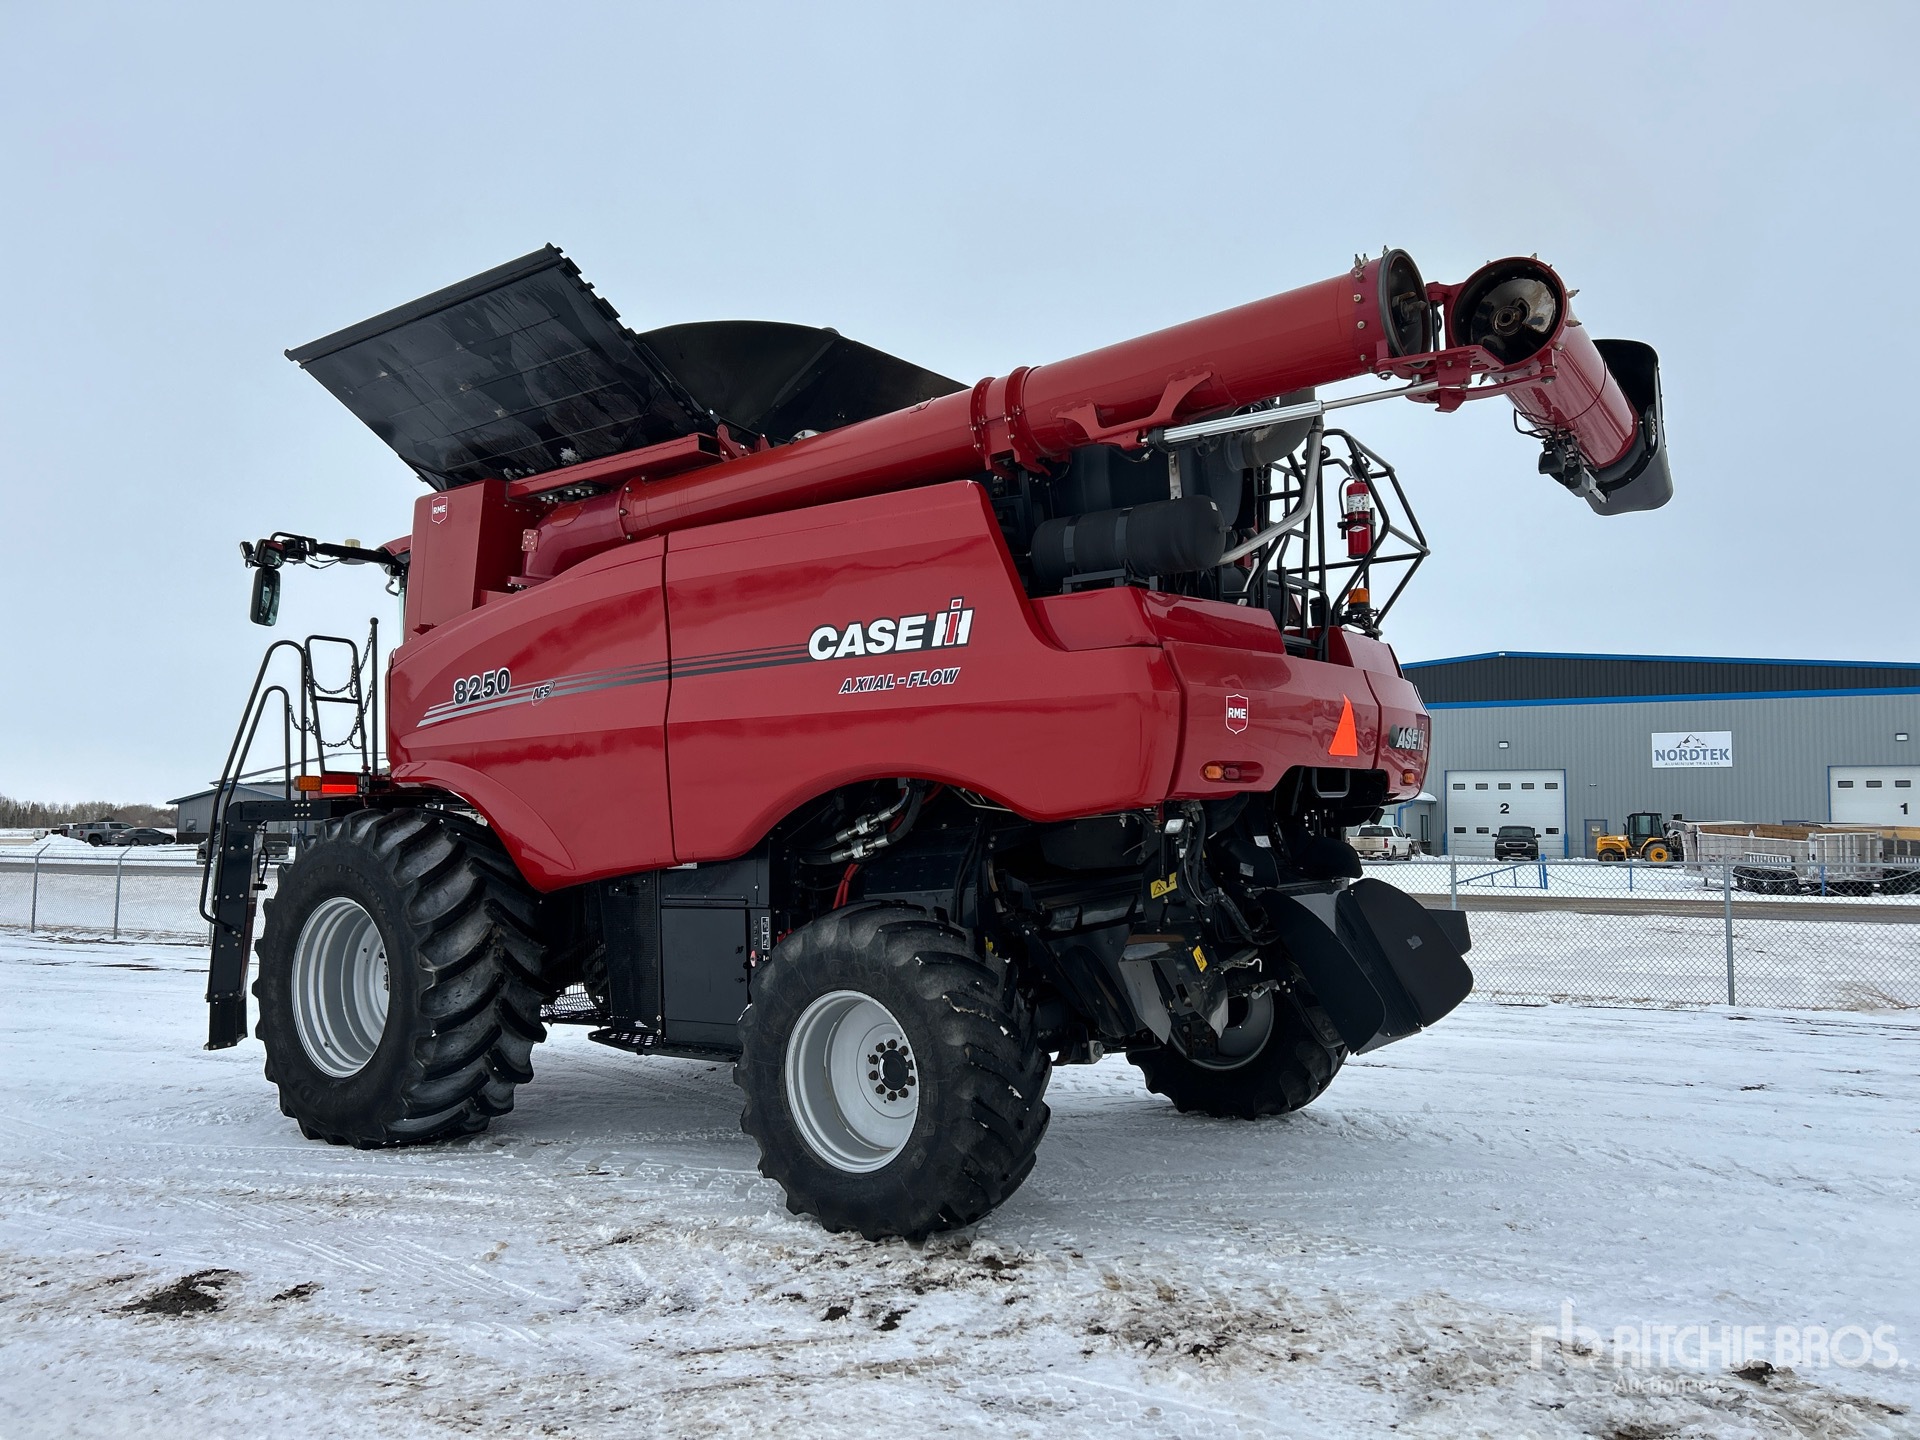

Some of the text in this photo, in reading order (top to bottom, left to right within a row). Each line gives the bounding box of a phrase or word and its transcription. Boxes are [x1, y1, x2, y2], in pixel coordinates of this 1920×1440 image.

[433, 504, 446, 515] RME
[808, 613, 927, 661] CASE
[453, 666, 511, 705] 8250
[533, 685, 550, 700] AFS
[1228, 707, 1247, 719] RME
[1654, 748, 1730, 761] NORDTEK
[1499, 803, 1510, 814] 2
[1900, 802, 1909, 815] 1
